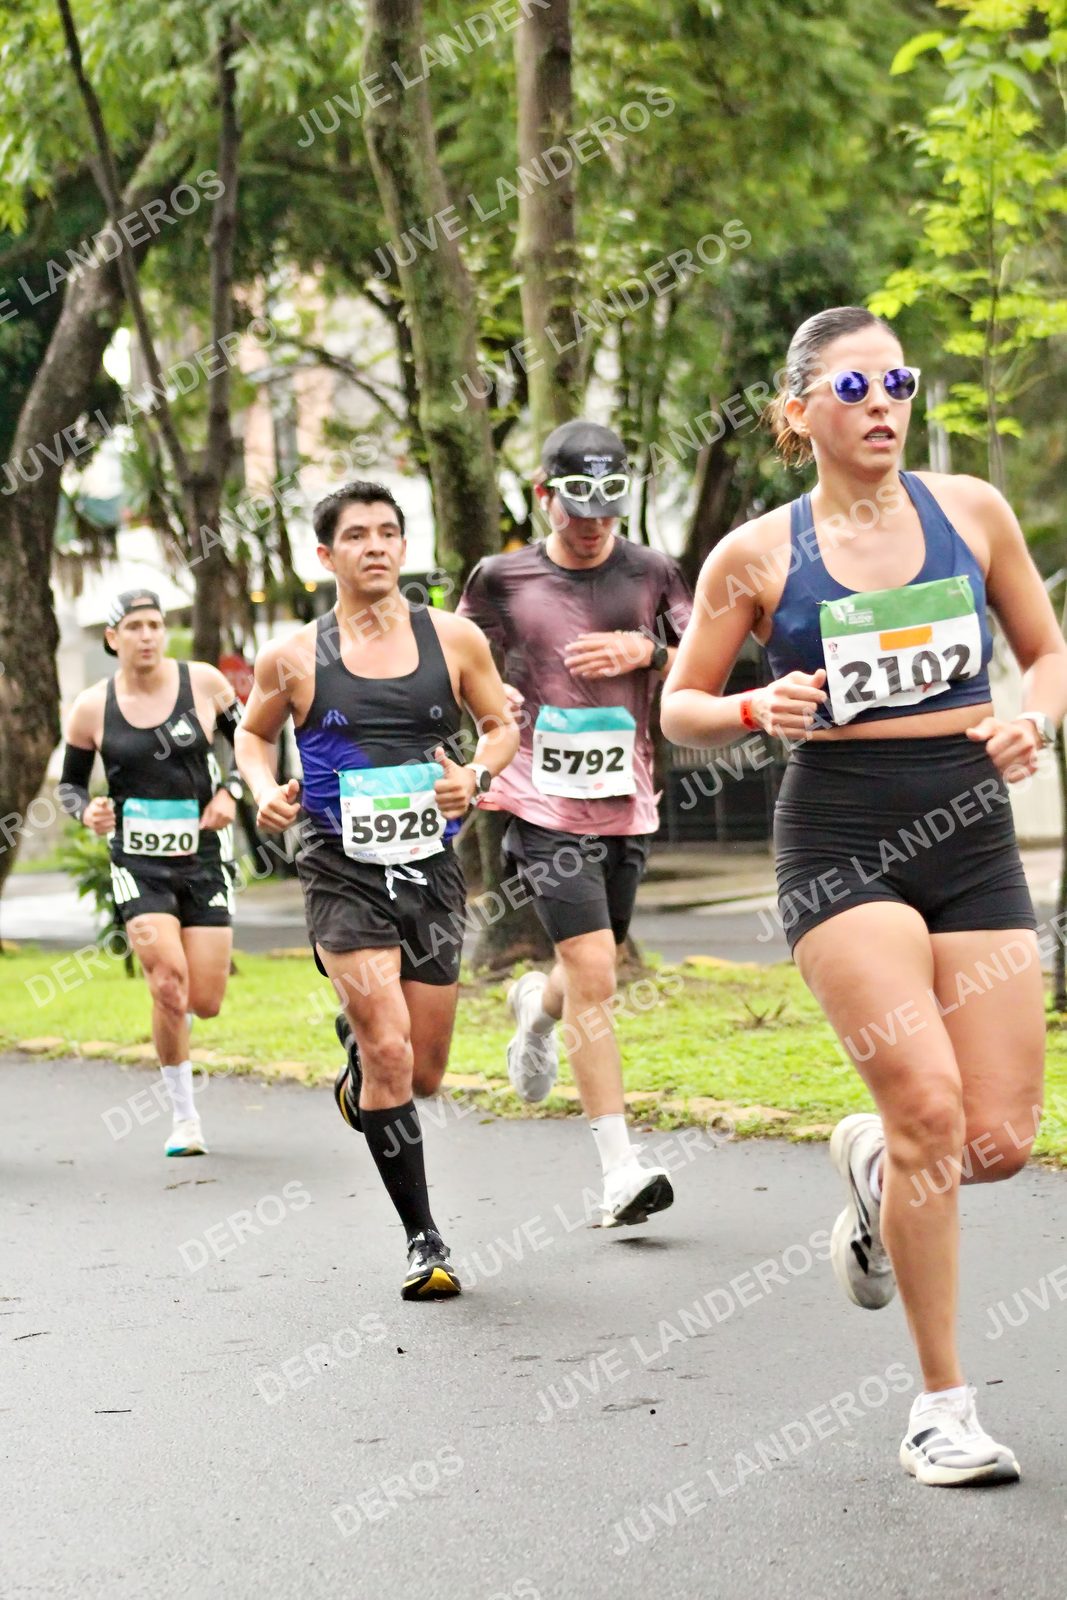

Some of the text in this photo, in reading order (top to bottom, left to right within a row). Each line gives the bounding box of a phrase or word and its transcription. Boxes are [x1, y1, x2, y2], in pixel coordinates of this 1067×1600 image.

[839, 644, 971, 704] 2102
[541, 746, 624, 775] 5792
[129, 831, 193, 852] 5920
[351, 807, 440, 844] 5928
